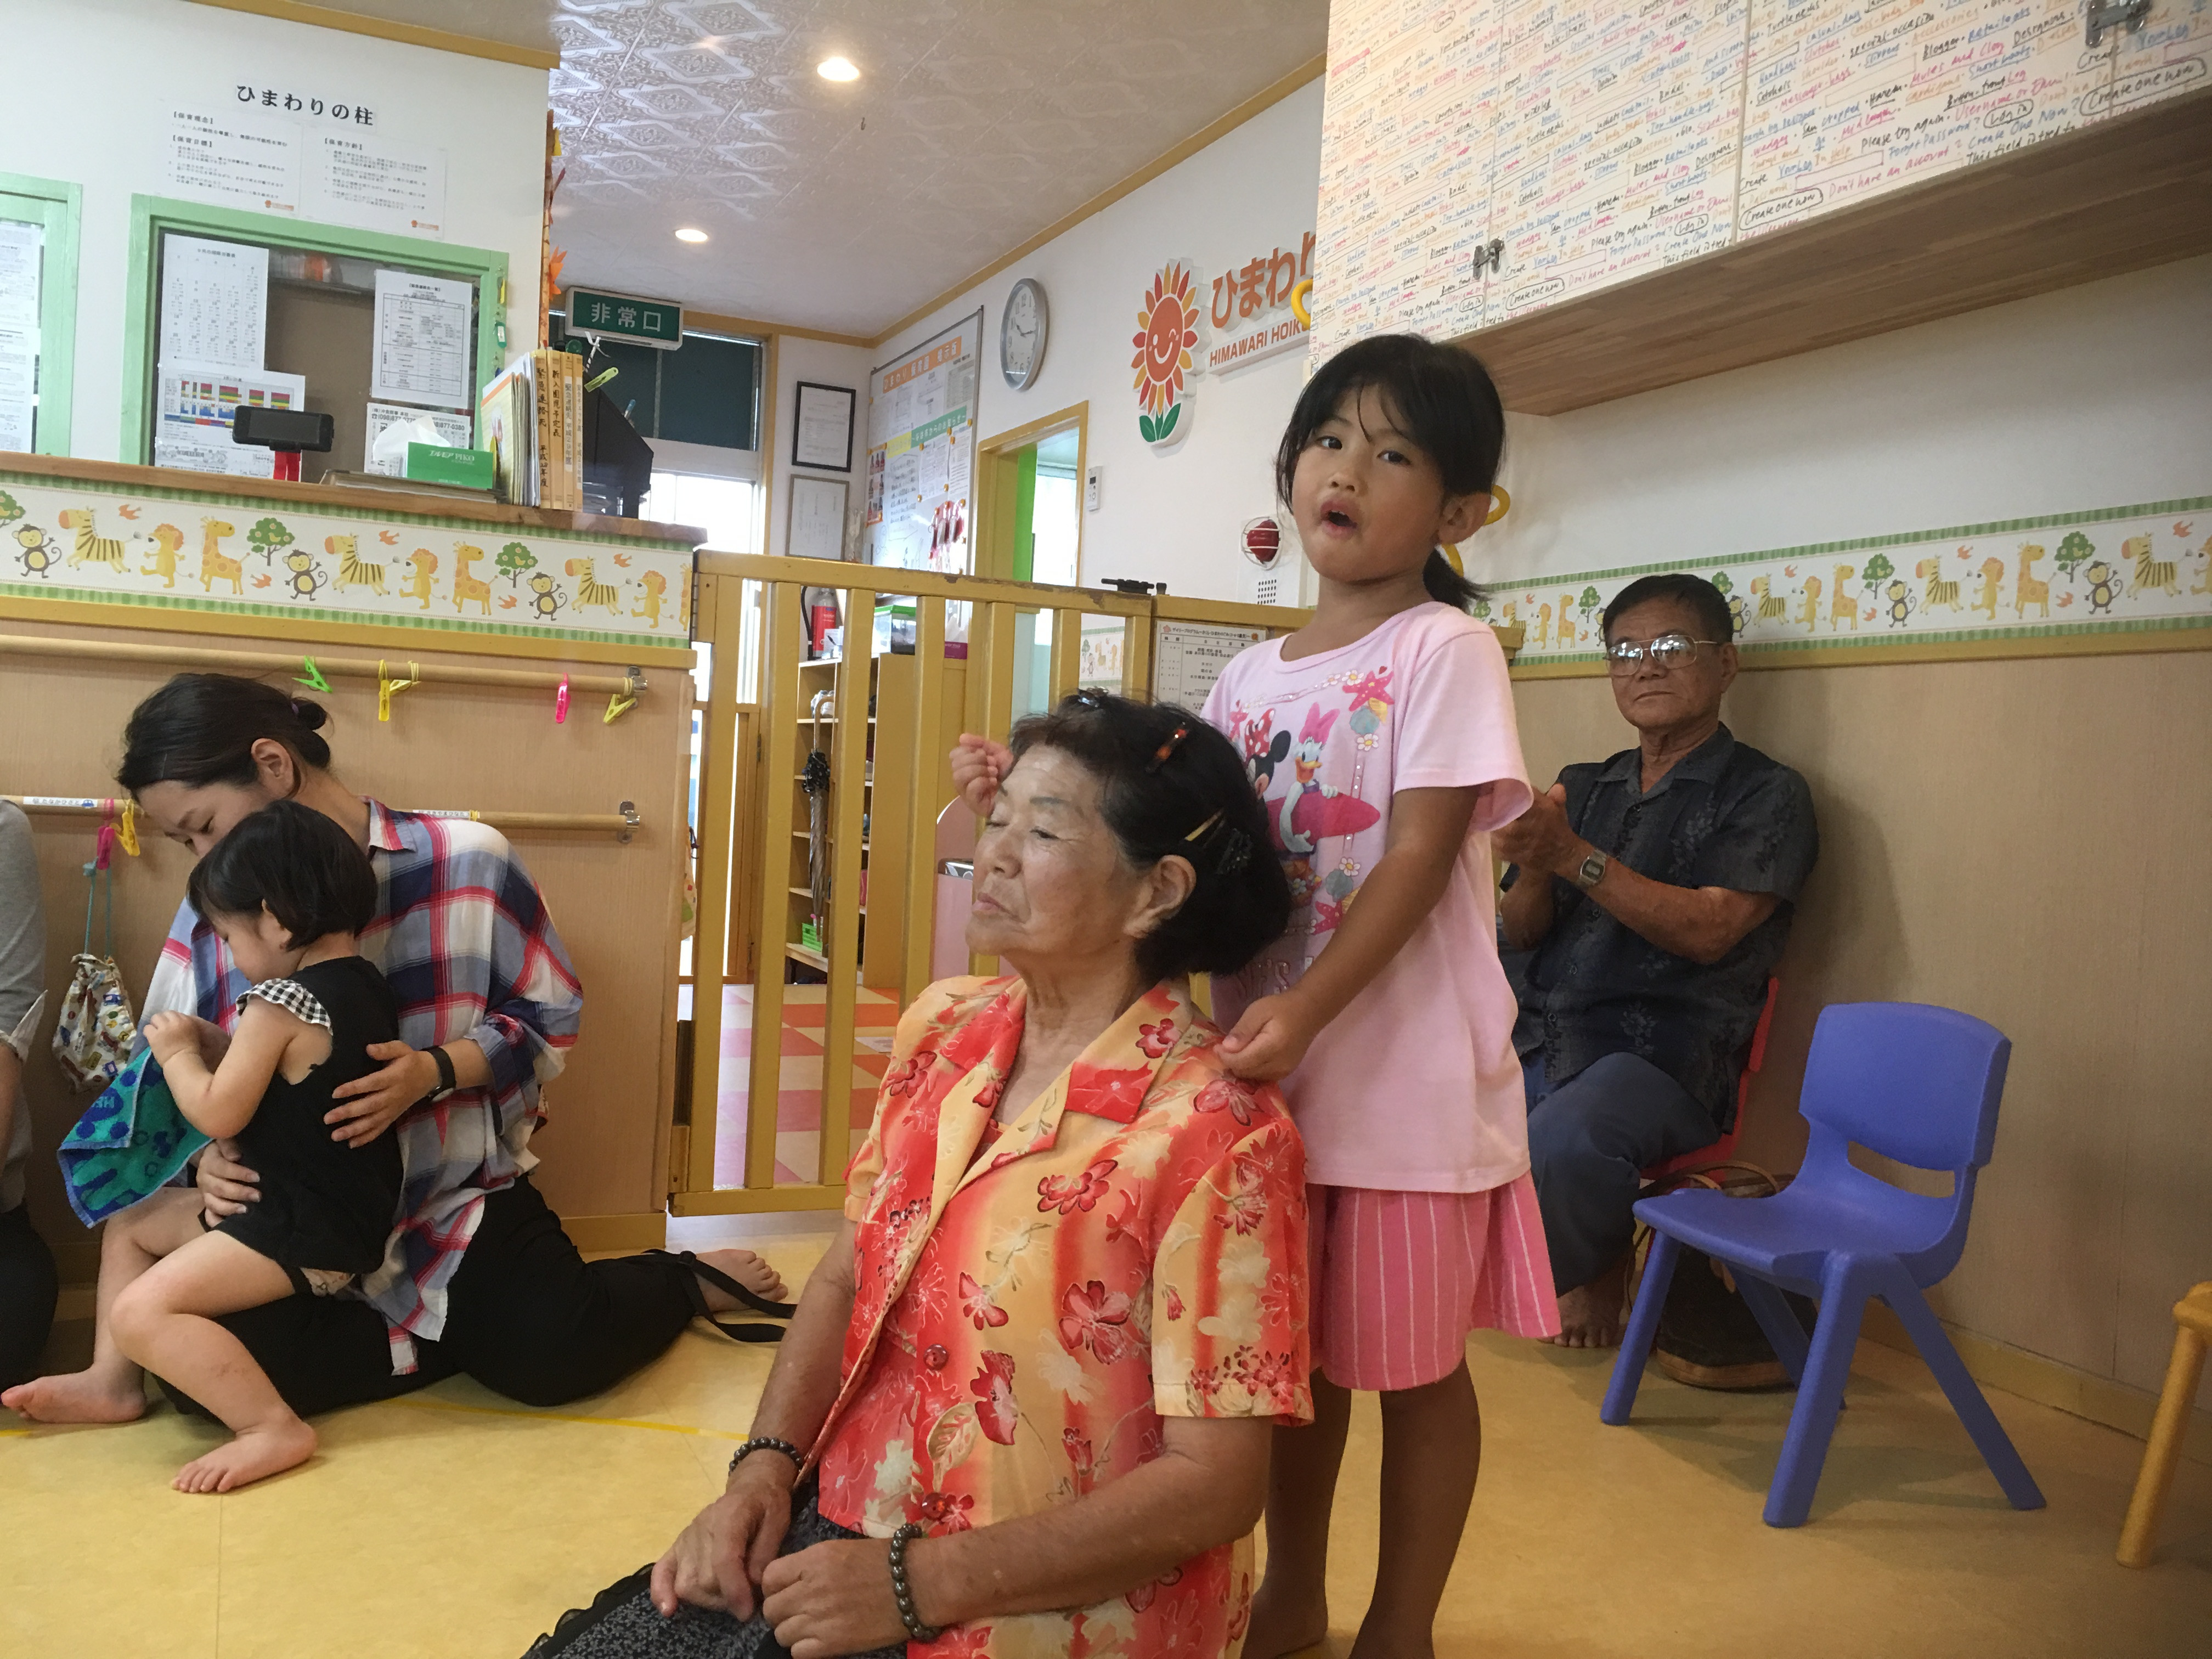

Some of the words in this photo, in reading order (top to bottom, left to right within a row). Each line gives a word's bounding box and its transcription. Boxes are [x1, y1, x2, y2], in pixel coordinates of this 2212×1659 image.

[1923, 38, 1959, 60] Blogger
[2135, 74, 2161, 91] one
[237, 85, 374, 126] ひまわりの柱
[1740, 174, 1768, 190] Create
[1745, 205, 1774, 225] Create
[1775, 198, 1793, 213] one
[1504, 264, 1526, 278] Create
[591, 302, 661, 332] 非常口
[1210, 330, 1267, 367] HIMAWARI
